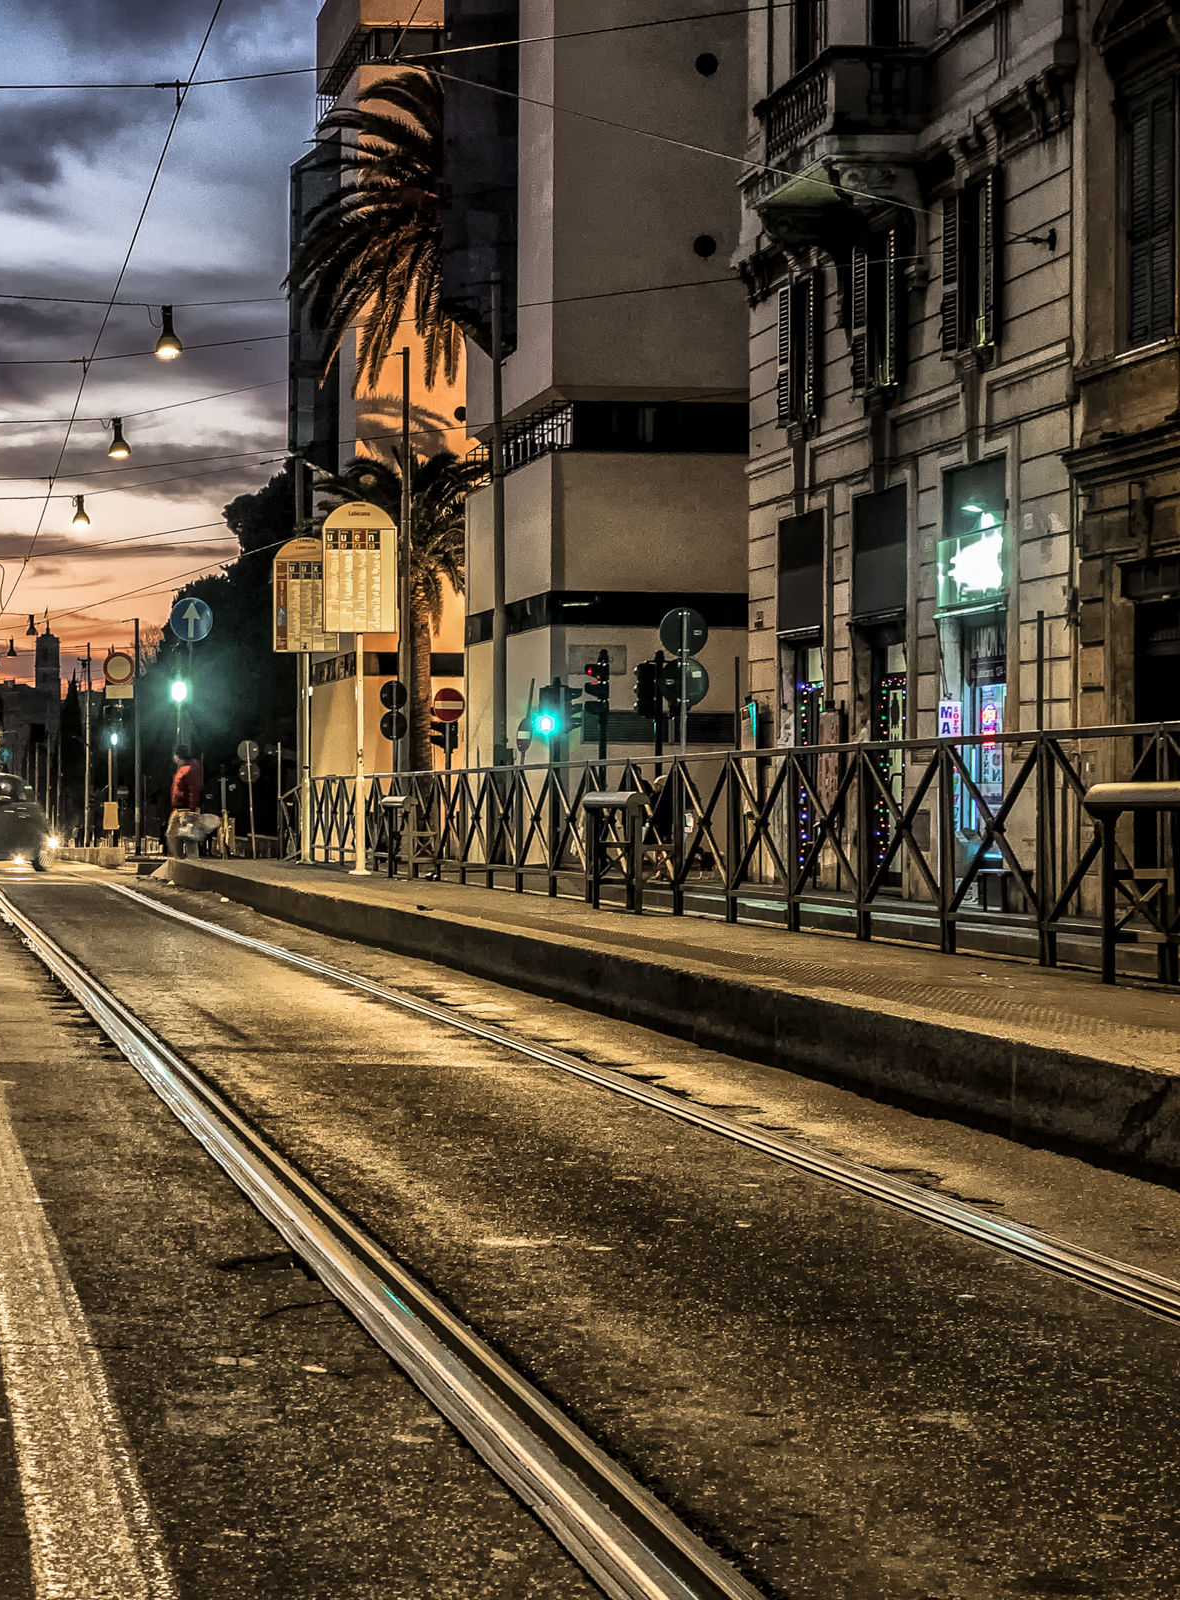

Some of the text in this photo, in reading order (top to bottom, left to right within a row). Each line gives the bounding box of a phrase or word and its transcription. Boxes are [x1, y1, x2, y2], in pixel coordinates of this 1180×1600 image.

[327, 534, 375, 542] u u e n
